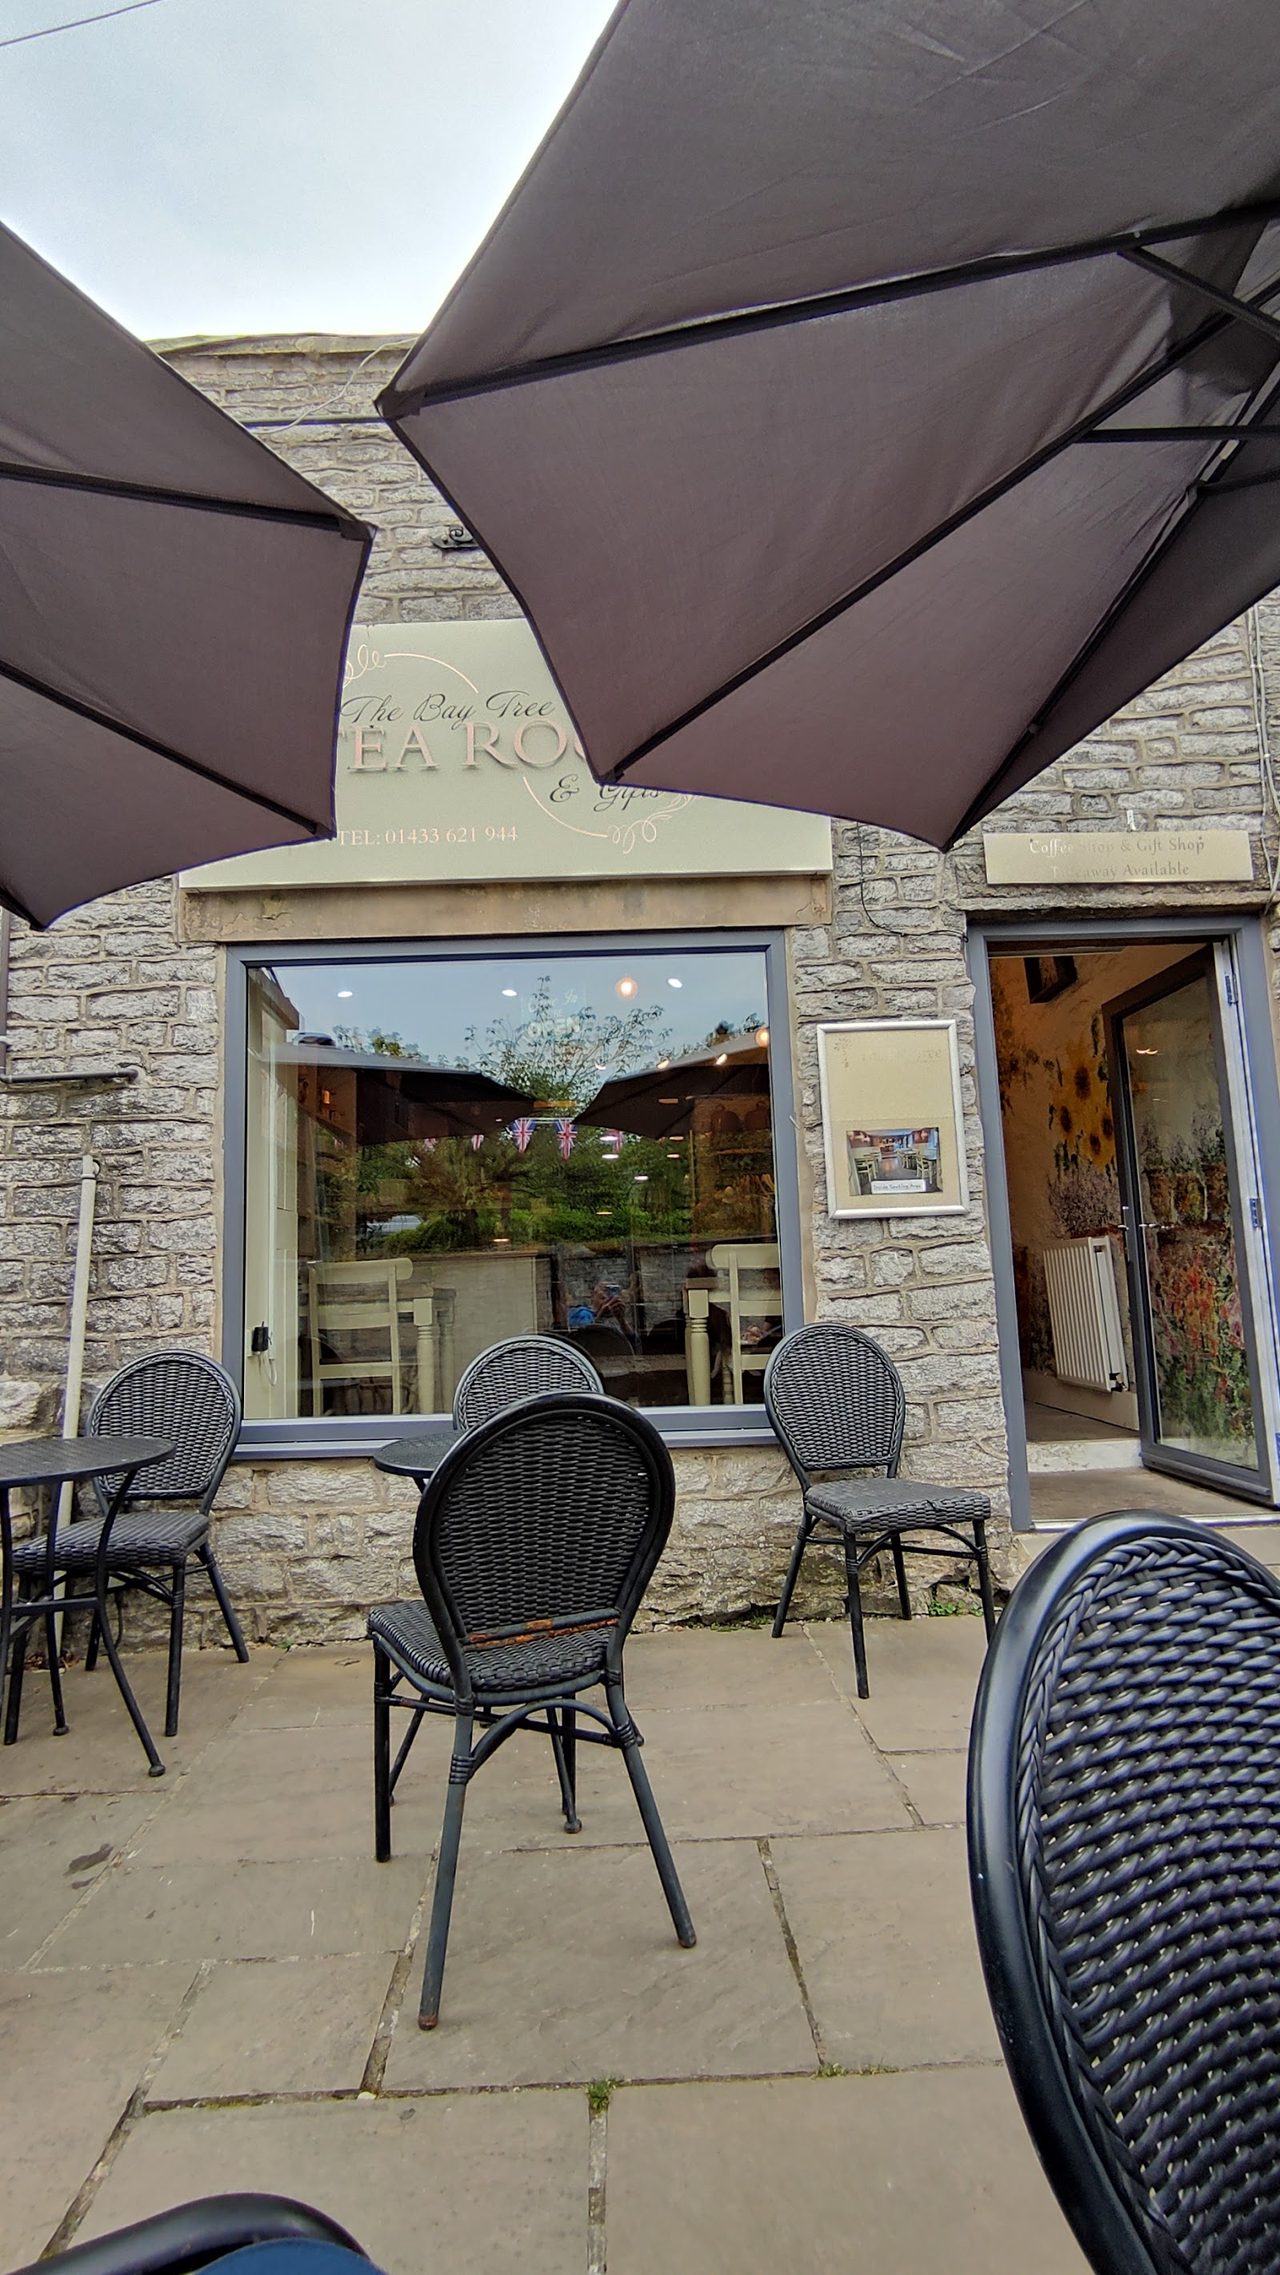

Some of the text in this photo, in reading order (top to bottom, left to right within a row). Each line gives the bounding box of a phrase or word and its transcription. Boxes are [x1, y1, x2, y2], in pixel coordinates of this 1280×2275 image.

[340, 690, 556, 730] The Bay Tree
[338, 724, 440, 770] EA
[550, 774, 580, 803] &
[338, 825, 518, 846] TEL: 01433 621 944
[1120, 839, 1132, 852] &
[1136, 837, 1161, 856] Gift
[1169, 836, 1205, 855] Shop
[1123, 861, 1190, 877] Available
